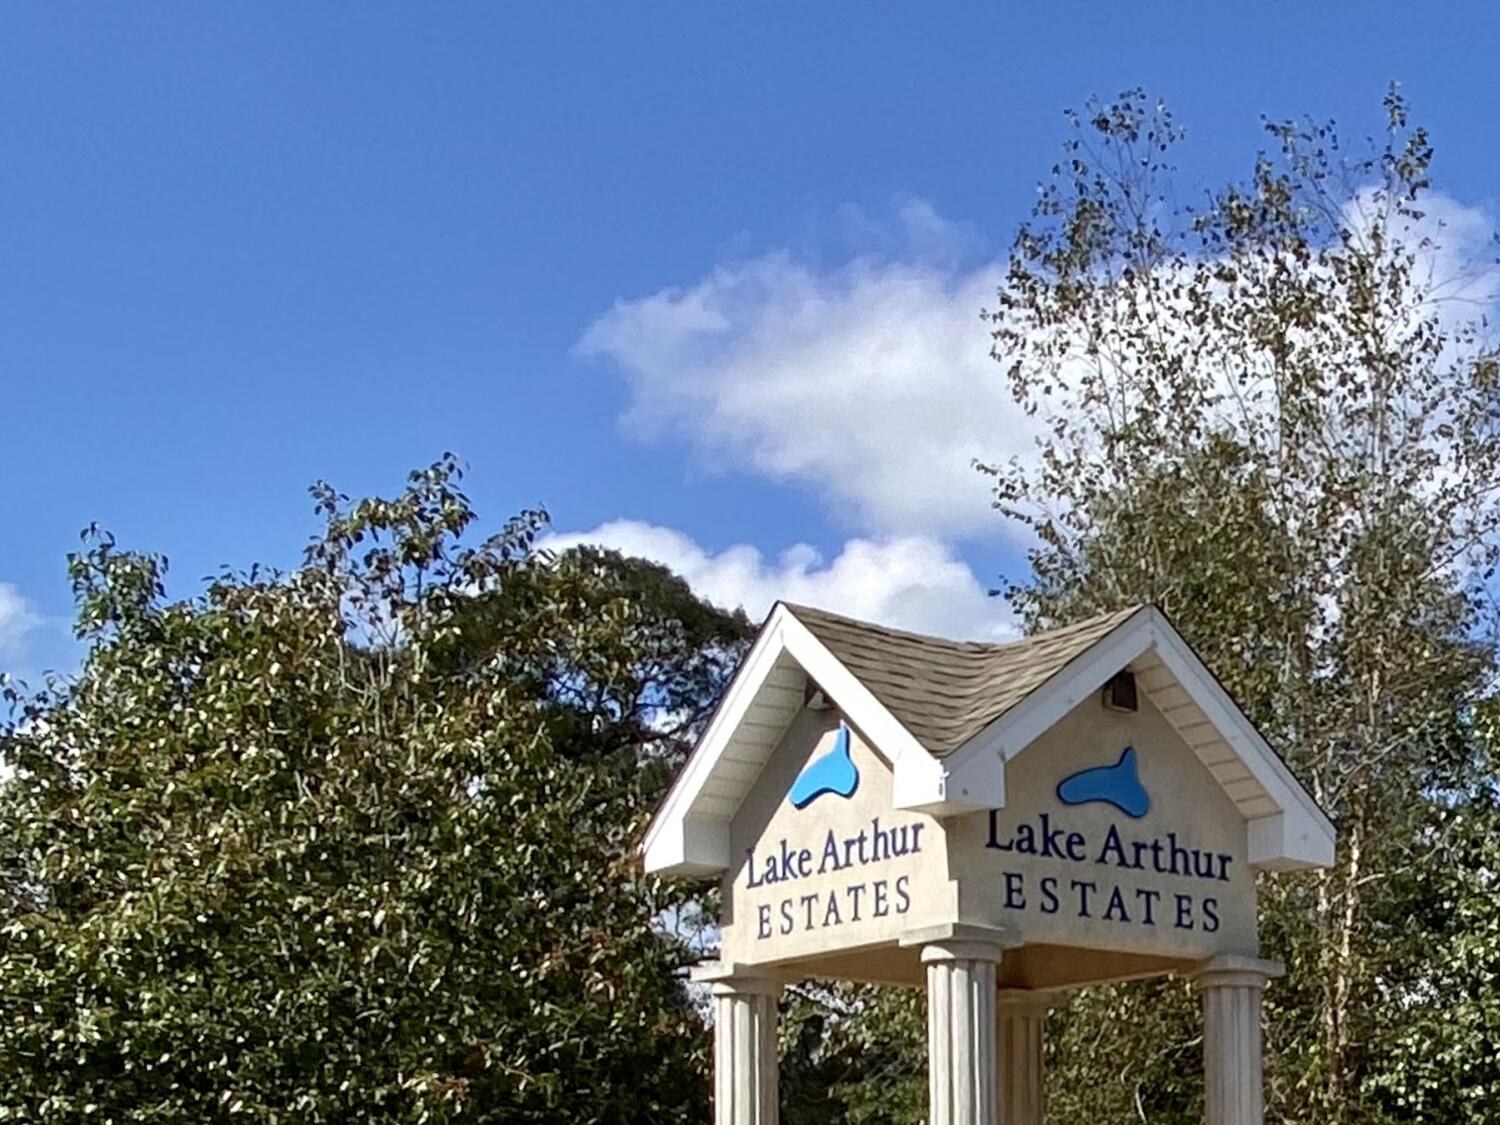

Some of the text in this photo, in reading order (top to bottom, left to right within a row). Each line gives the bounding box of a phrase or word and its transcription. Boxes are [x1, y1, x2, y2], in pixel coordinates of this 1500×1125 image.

[745, 816, 925, 890] Lake Arthur
[985, 808, 1233, 882] Lake Arthur
[757, 875, 911, 940] ESTATES
[1002, 871, 1220, 933] ESTATES
